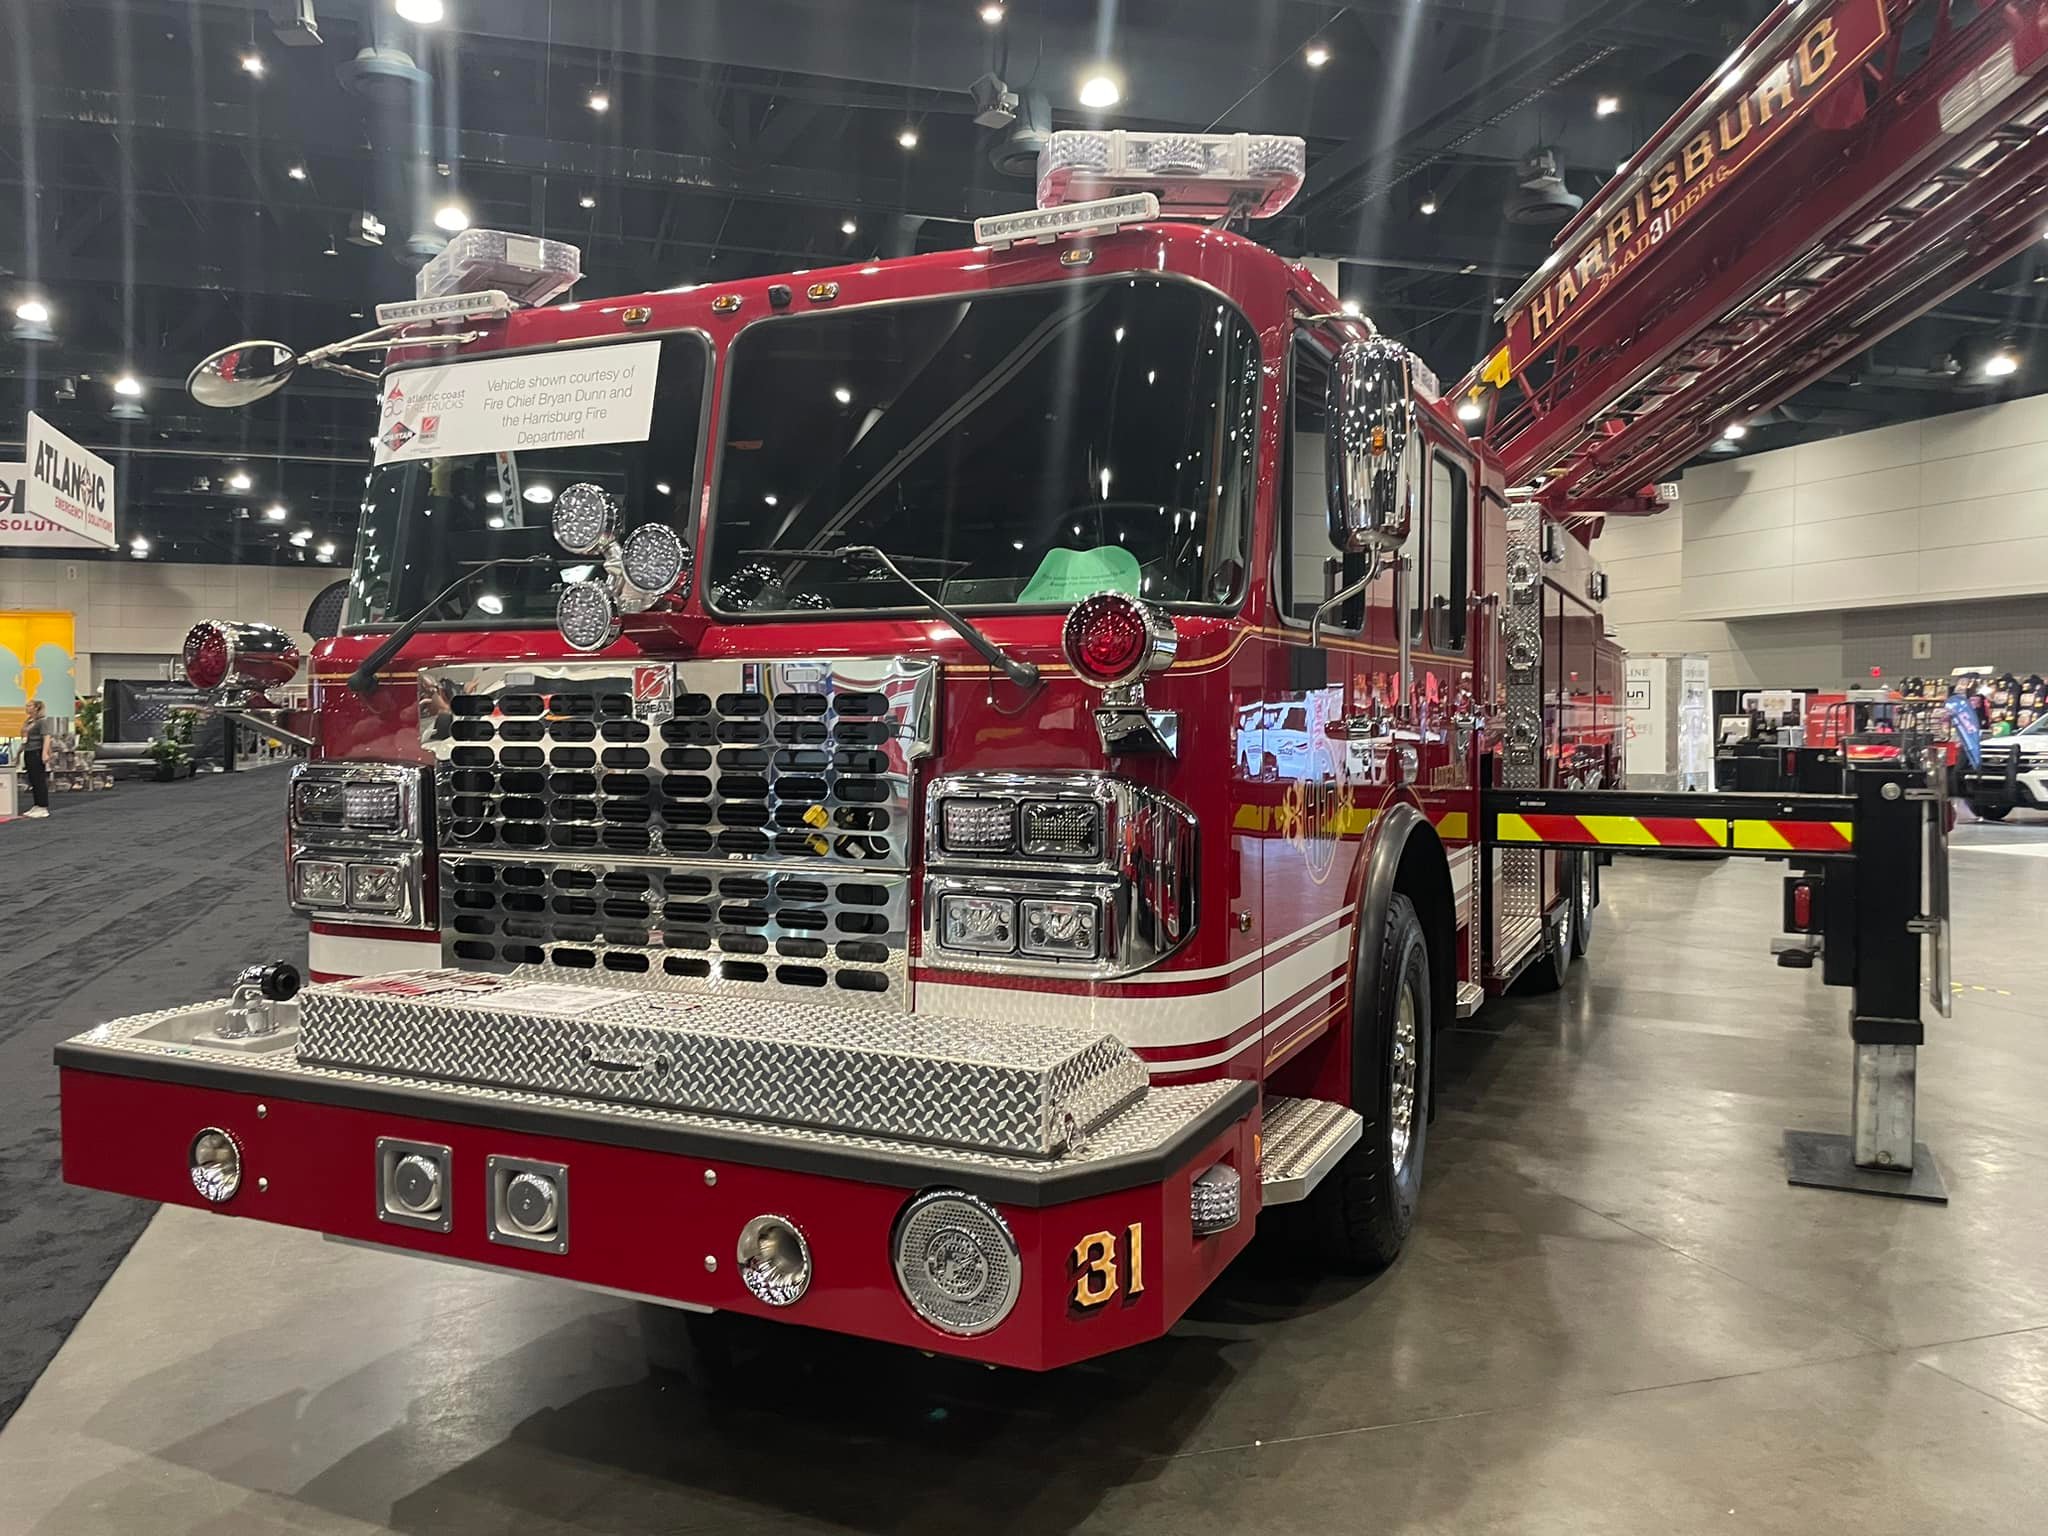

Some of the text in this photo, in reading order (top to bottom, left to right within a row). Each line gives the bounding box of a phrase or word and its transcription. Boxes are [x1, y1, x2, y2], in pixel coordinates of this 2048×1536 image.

[1530, 16, 1839, 341] HARRISBURG
[487, 364, 636, 392] Vehicle shown courtesy of
[407, 389, 465, 404] atlantic coast
[483, 384, 633, 411] Fire Chief Bryan Dunn and
[502, 406, 607, 427] the Harrisburg Fire
[517, 427, 585, 445] Department
[34, 439, 105, 513] ATLANIC
[1072, 1222, 1145, 1308] 31
